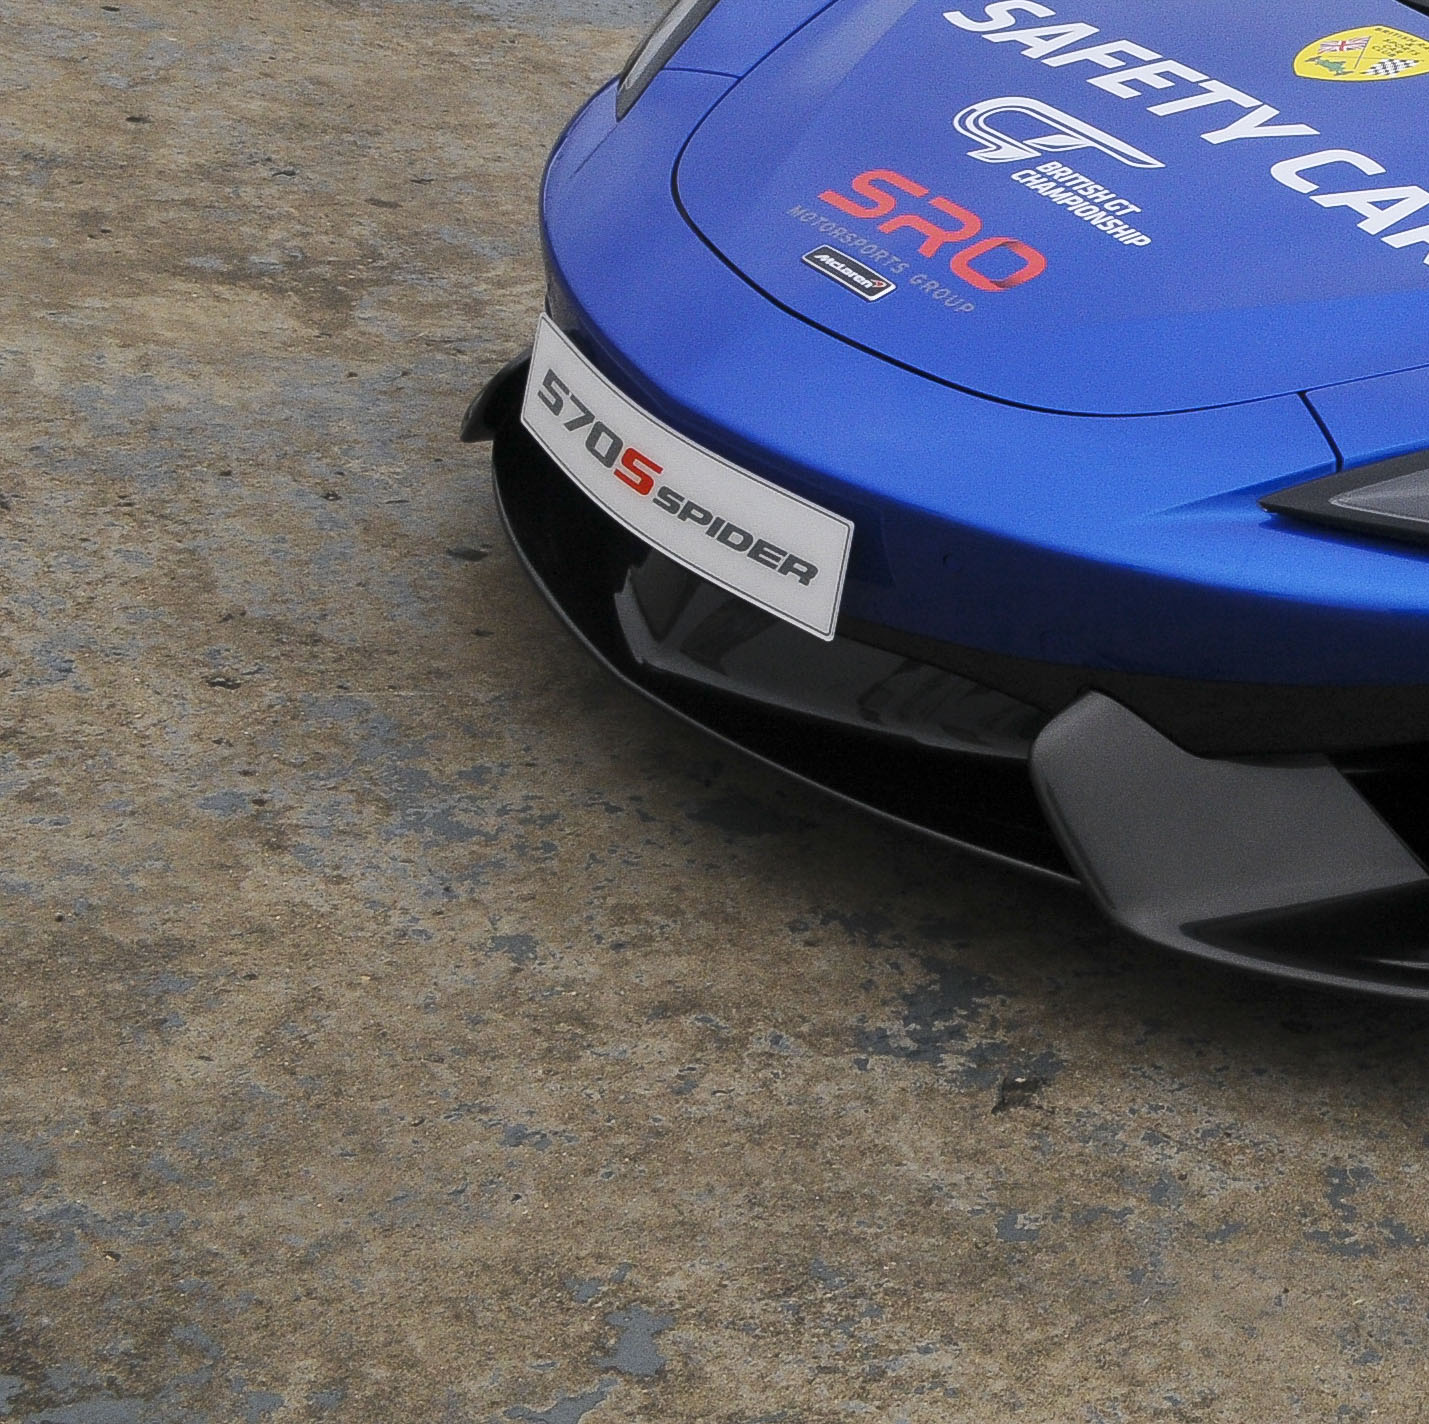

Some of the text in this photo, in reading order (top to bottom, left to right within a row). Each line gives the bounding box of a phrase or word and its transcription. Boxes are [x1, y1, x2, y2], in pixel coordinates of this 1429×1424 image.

[943, 0, 1320, 145] SAFETY
[817, 168, 1047, 292] SRO
[1010, 168, 1152, 247] CHAMPIONSHIP
[1036, 160, 1142, 217] BRITISH GT
[789, 205, 975, 312] MOTORSPORTS GROUP
[814, 254, 874, 289] McLaren
[537, 368, 819, 587] 570S SPIDER
